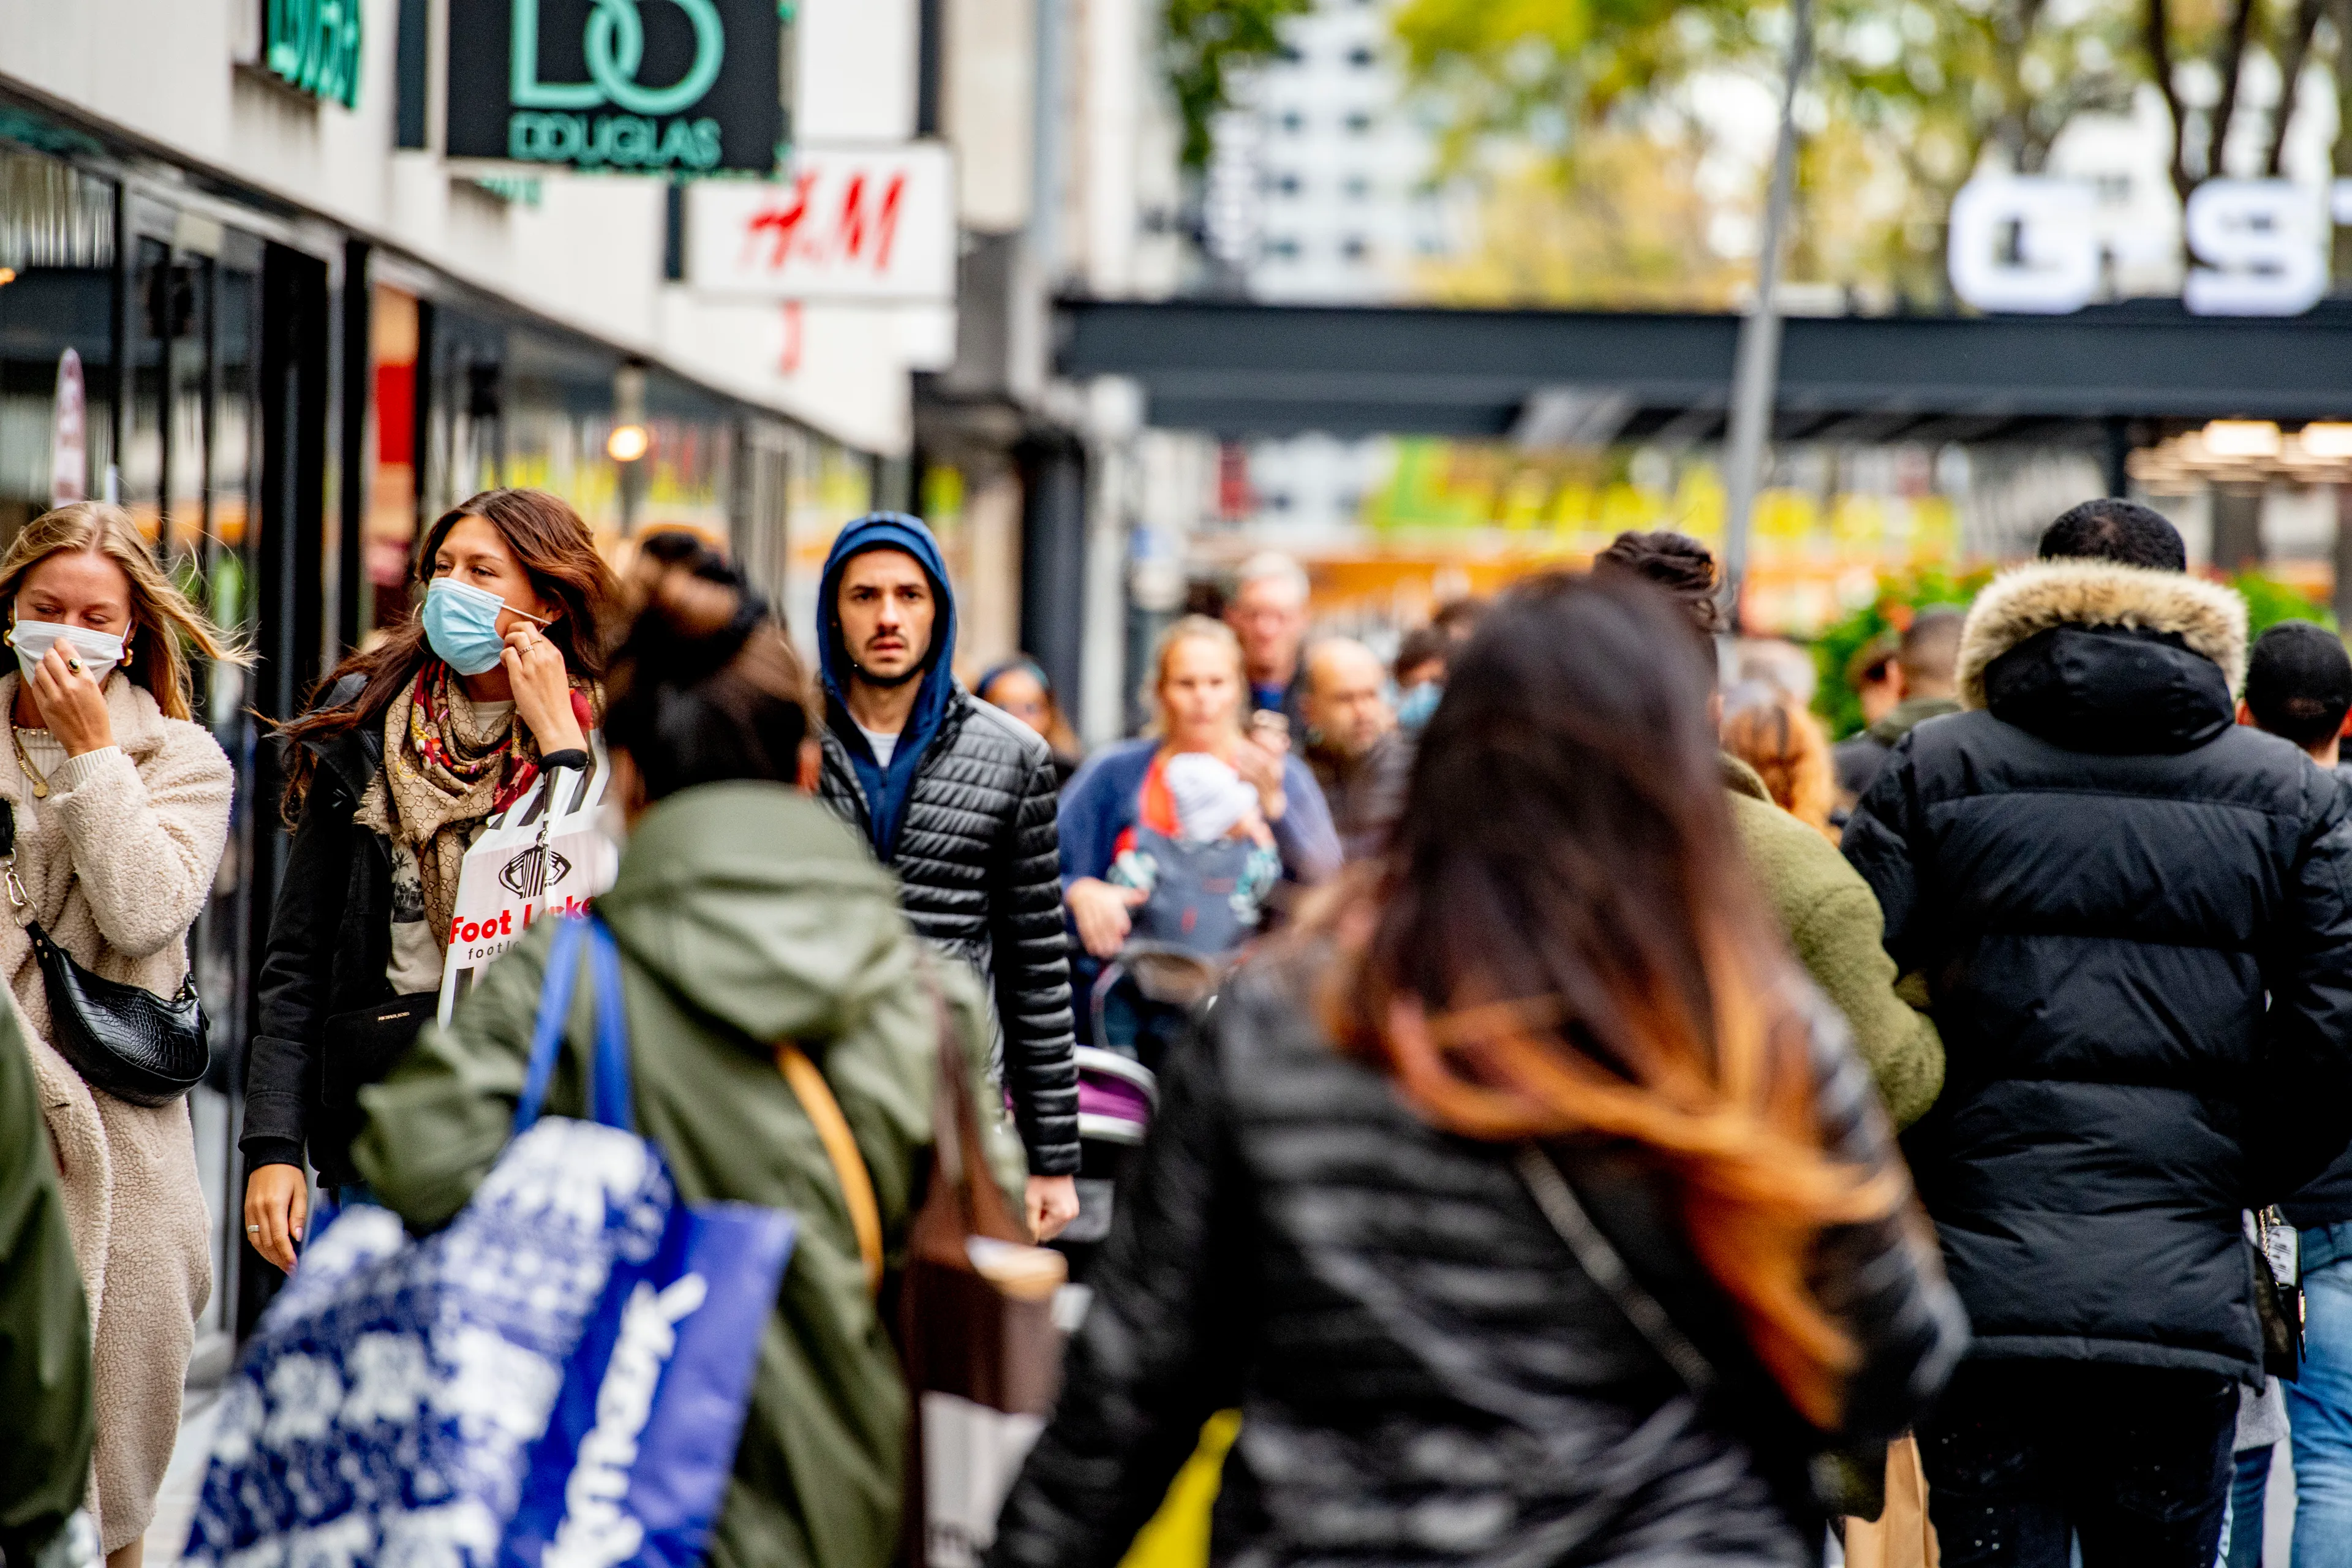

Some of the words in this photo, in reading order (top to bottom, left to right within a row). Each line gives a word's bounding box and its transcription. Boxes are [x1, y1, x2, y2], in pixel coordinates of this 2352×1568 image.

[508, 111, 723, 169] DOUGLAS
[742, 165, 905, 274] HM
[449, 910, 511, 944] Foot
